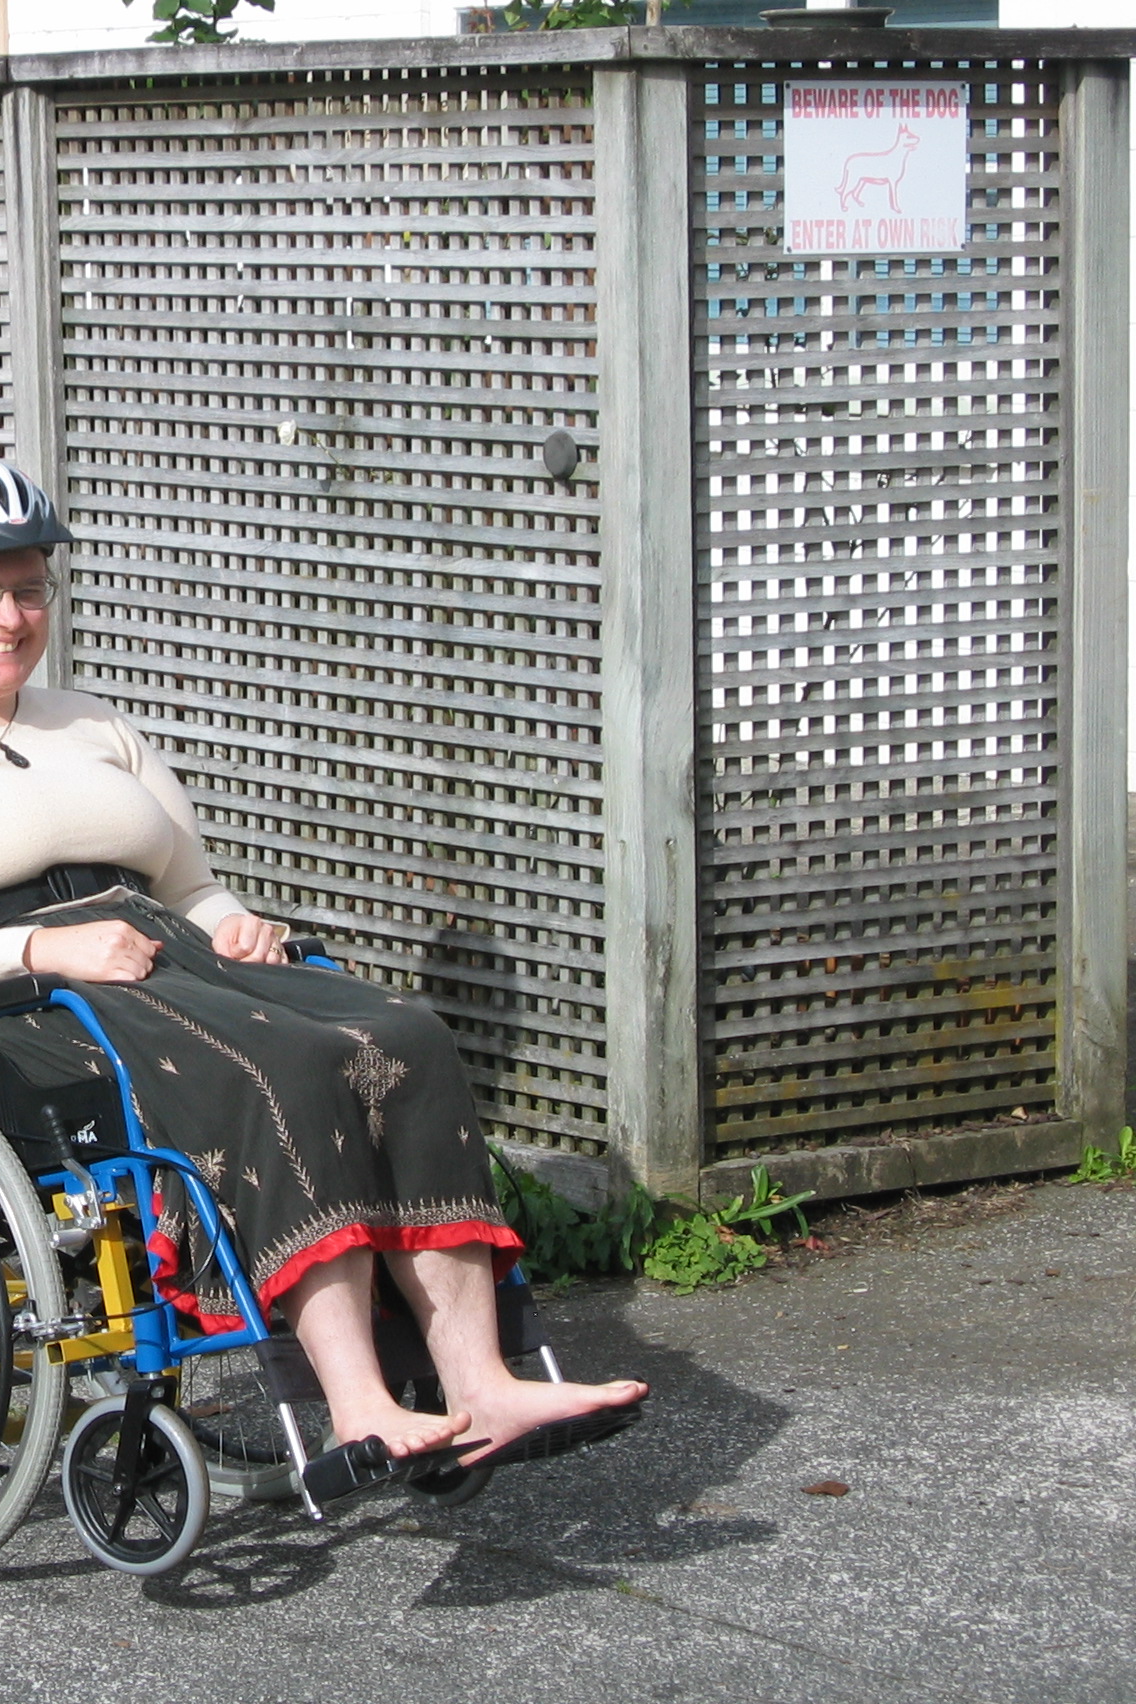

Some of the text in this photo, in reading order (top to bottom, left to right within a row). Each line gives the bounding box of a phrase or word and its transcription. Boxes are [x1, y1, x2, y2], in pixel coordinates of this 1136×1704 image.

[791, 88, 959, 119] BEWARE OF THE DOG
[791, 217, 958, 250] ENTER AT OWN RISK
